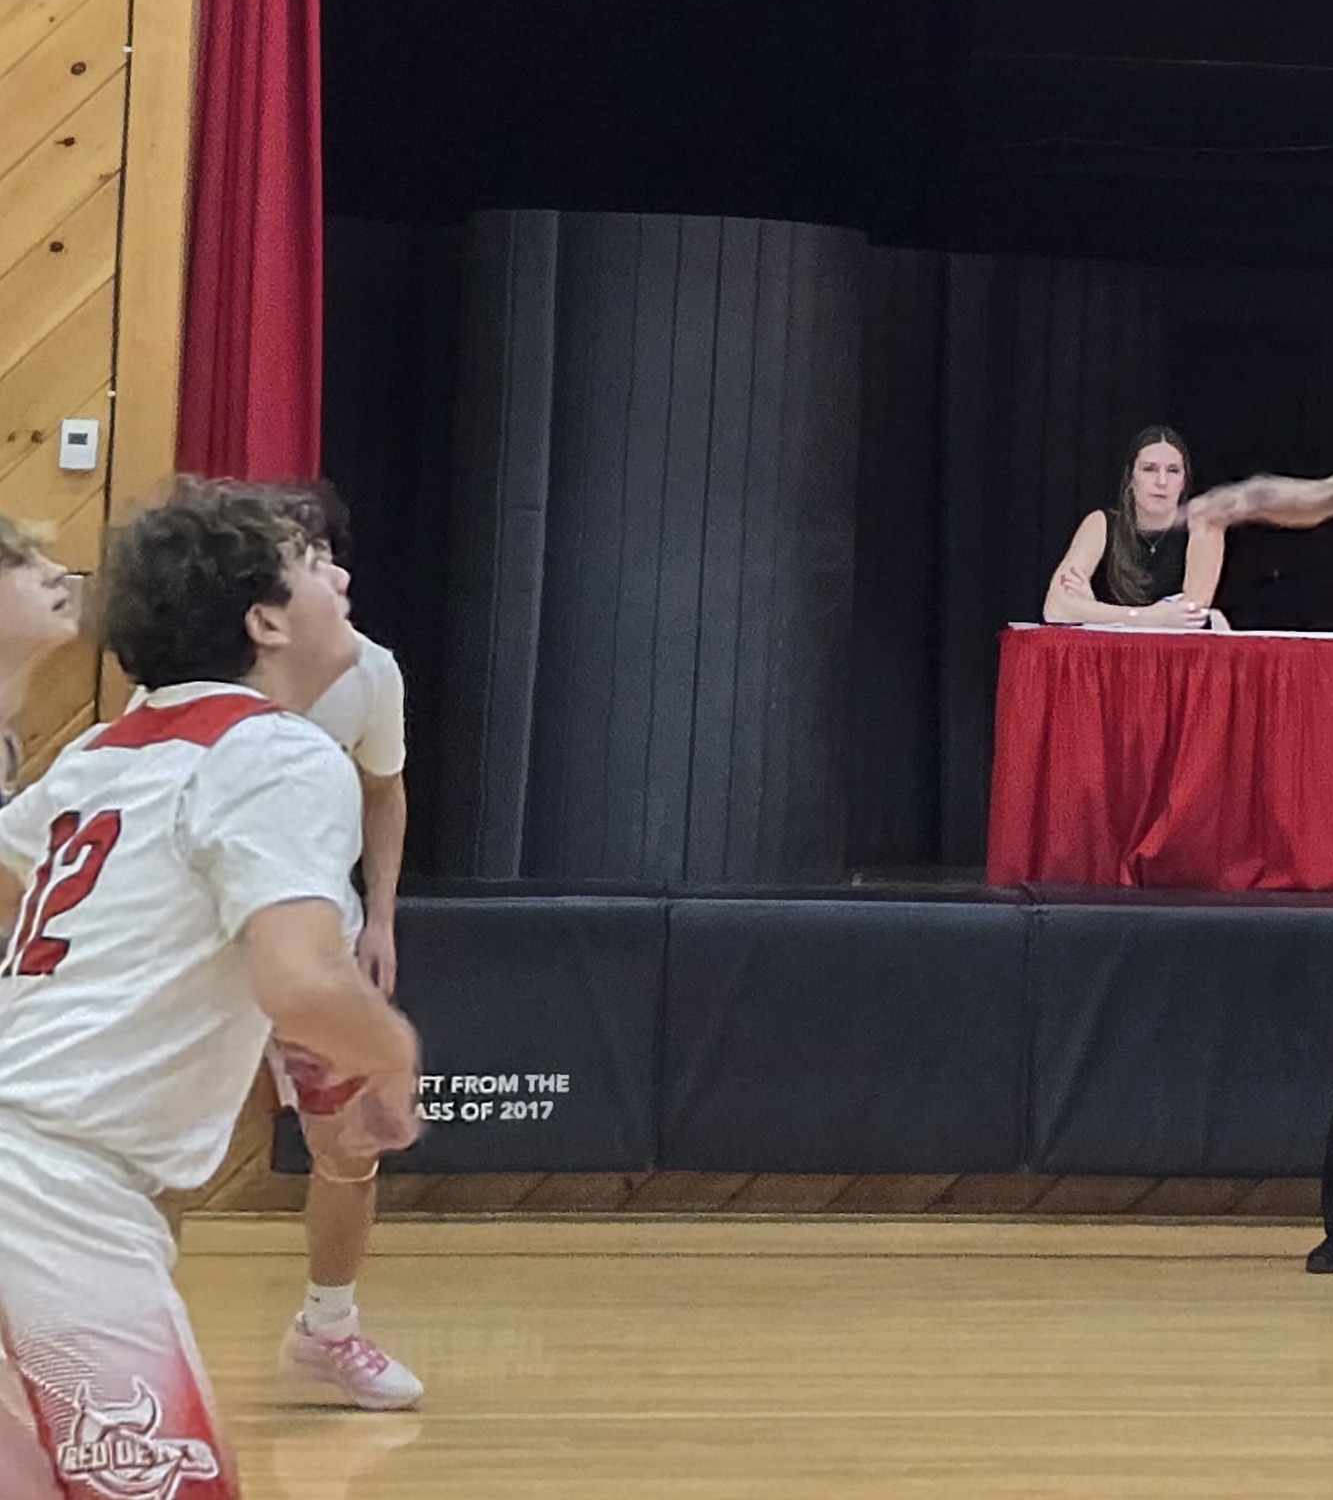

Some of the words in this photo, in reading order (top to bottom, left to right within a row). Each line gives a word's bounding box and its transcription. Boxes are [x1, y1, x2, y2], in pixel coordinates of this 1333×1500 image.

[418, 1074, 446, 1096] FT
[450, 1074, 519, 1095] FROM
[524, 1073, 570, 1094] THE
[415, 1101, 456, 1122] ASS
[460, 1100, 495, 1122] OF
[500, 1100, 554, 1121] 2017
